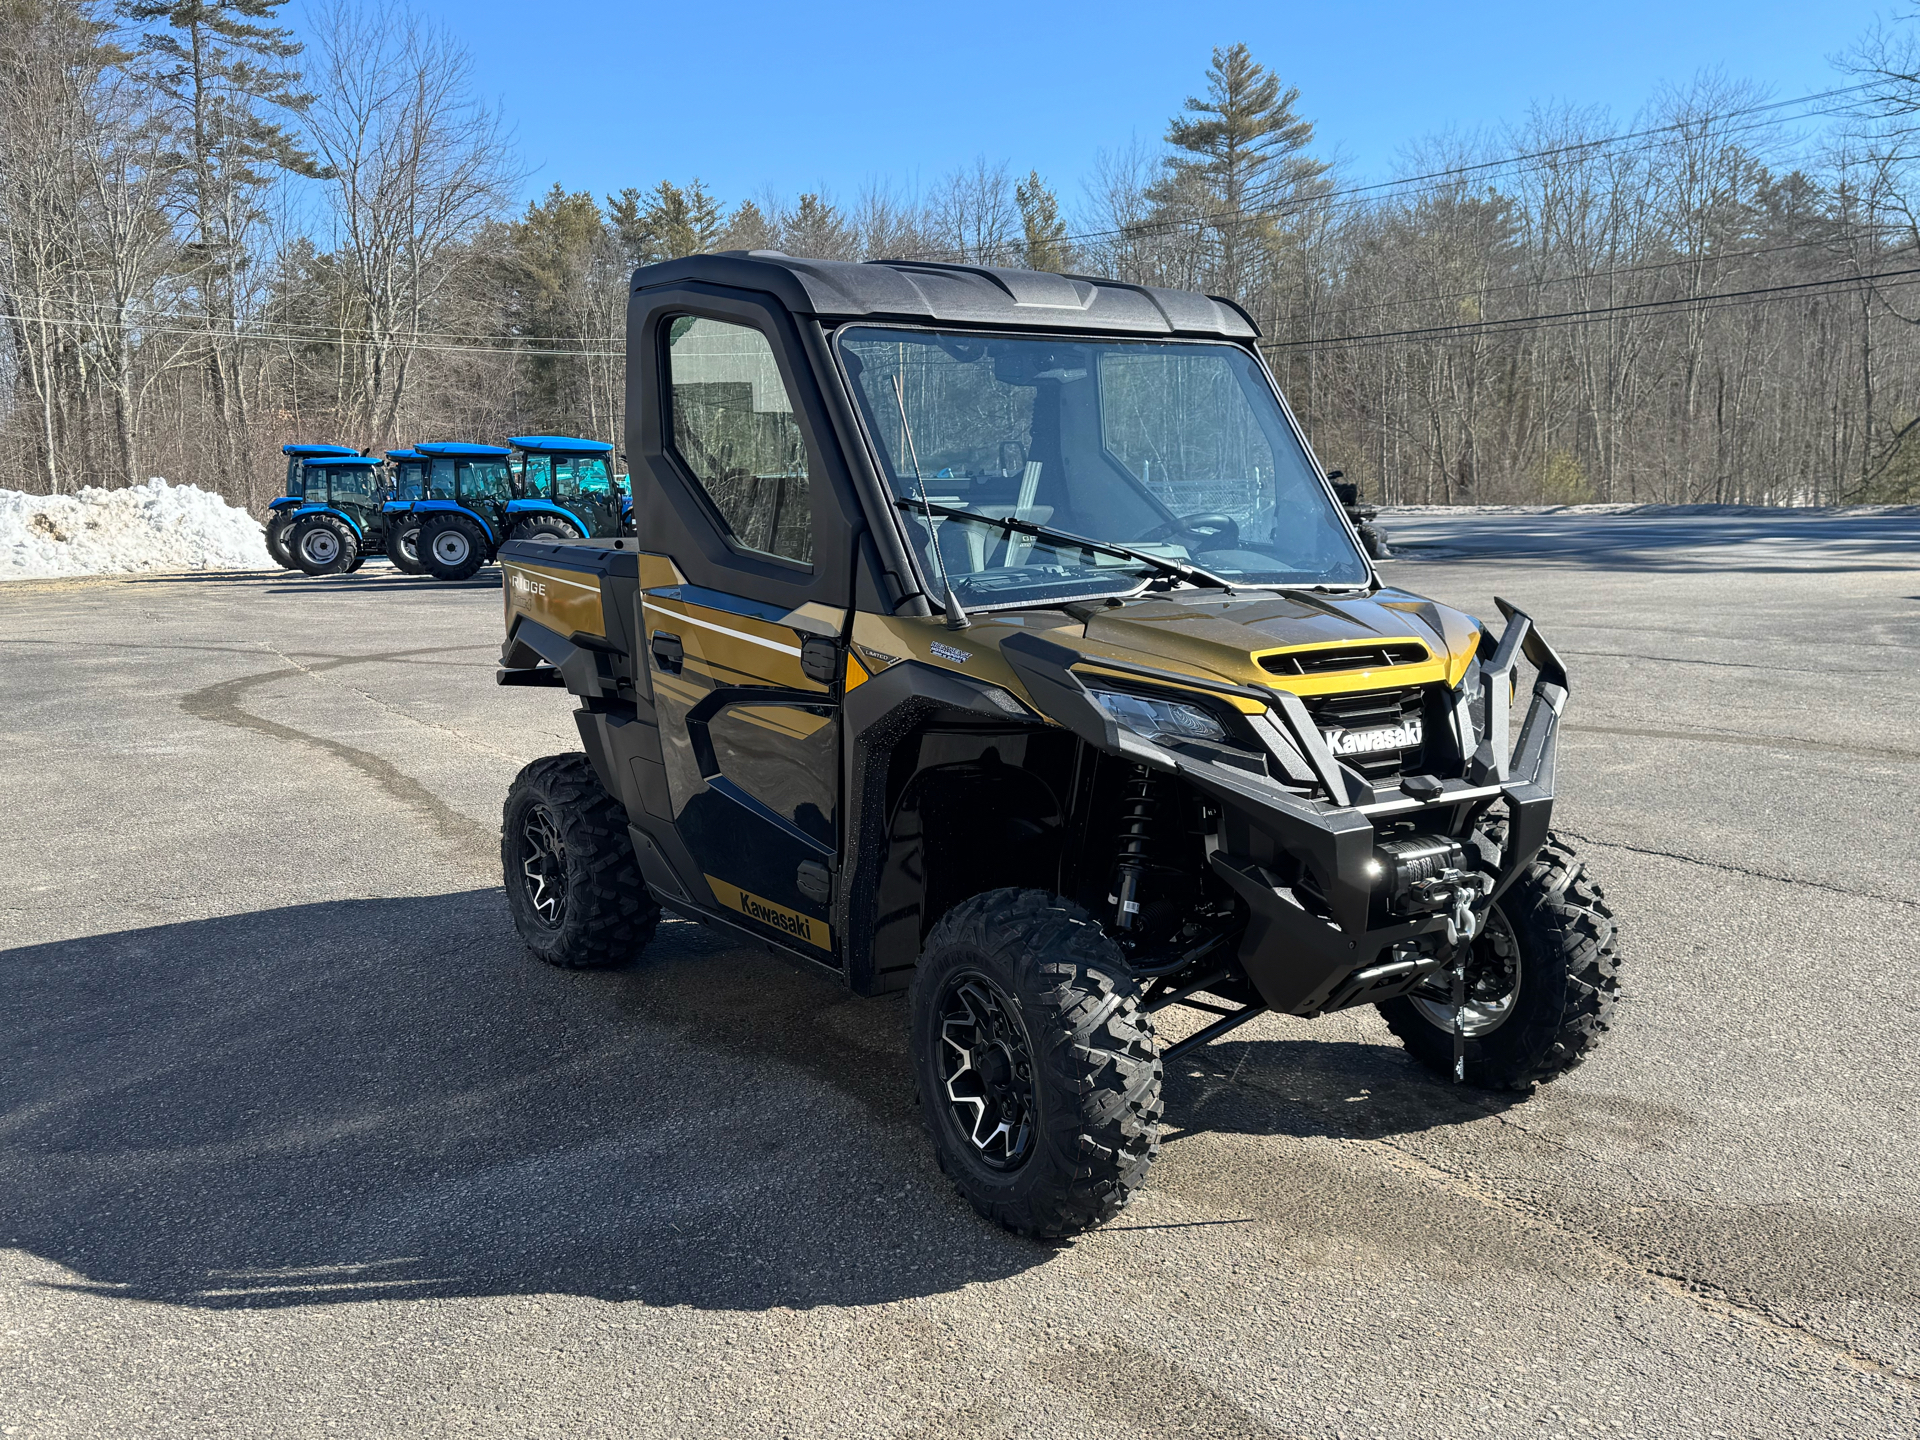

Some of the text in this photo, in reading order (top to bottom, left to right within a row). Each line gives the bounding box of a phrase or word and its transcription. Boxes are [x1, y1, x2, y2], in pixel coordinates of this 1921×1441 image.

[511, 575, 546, 596] RIDGE
[865, 649, 889, 661] LIMITED
[1325, 721, 1422, 755] Kawasaki
[739, 891, 812, 940] Kawasaki
